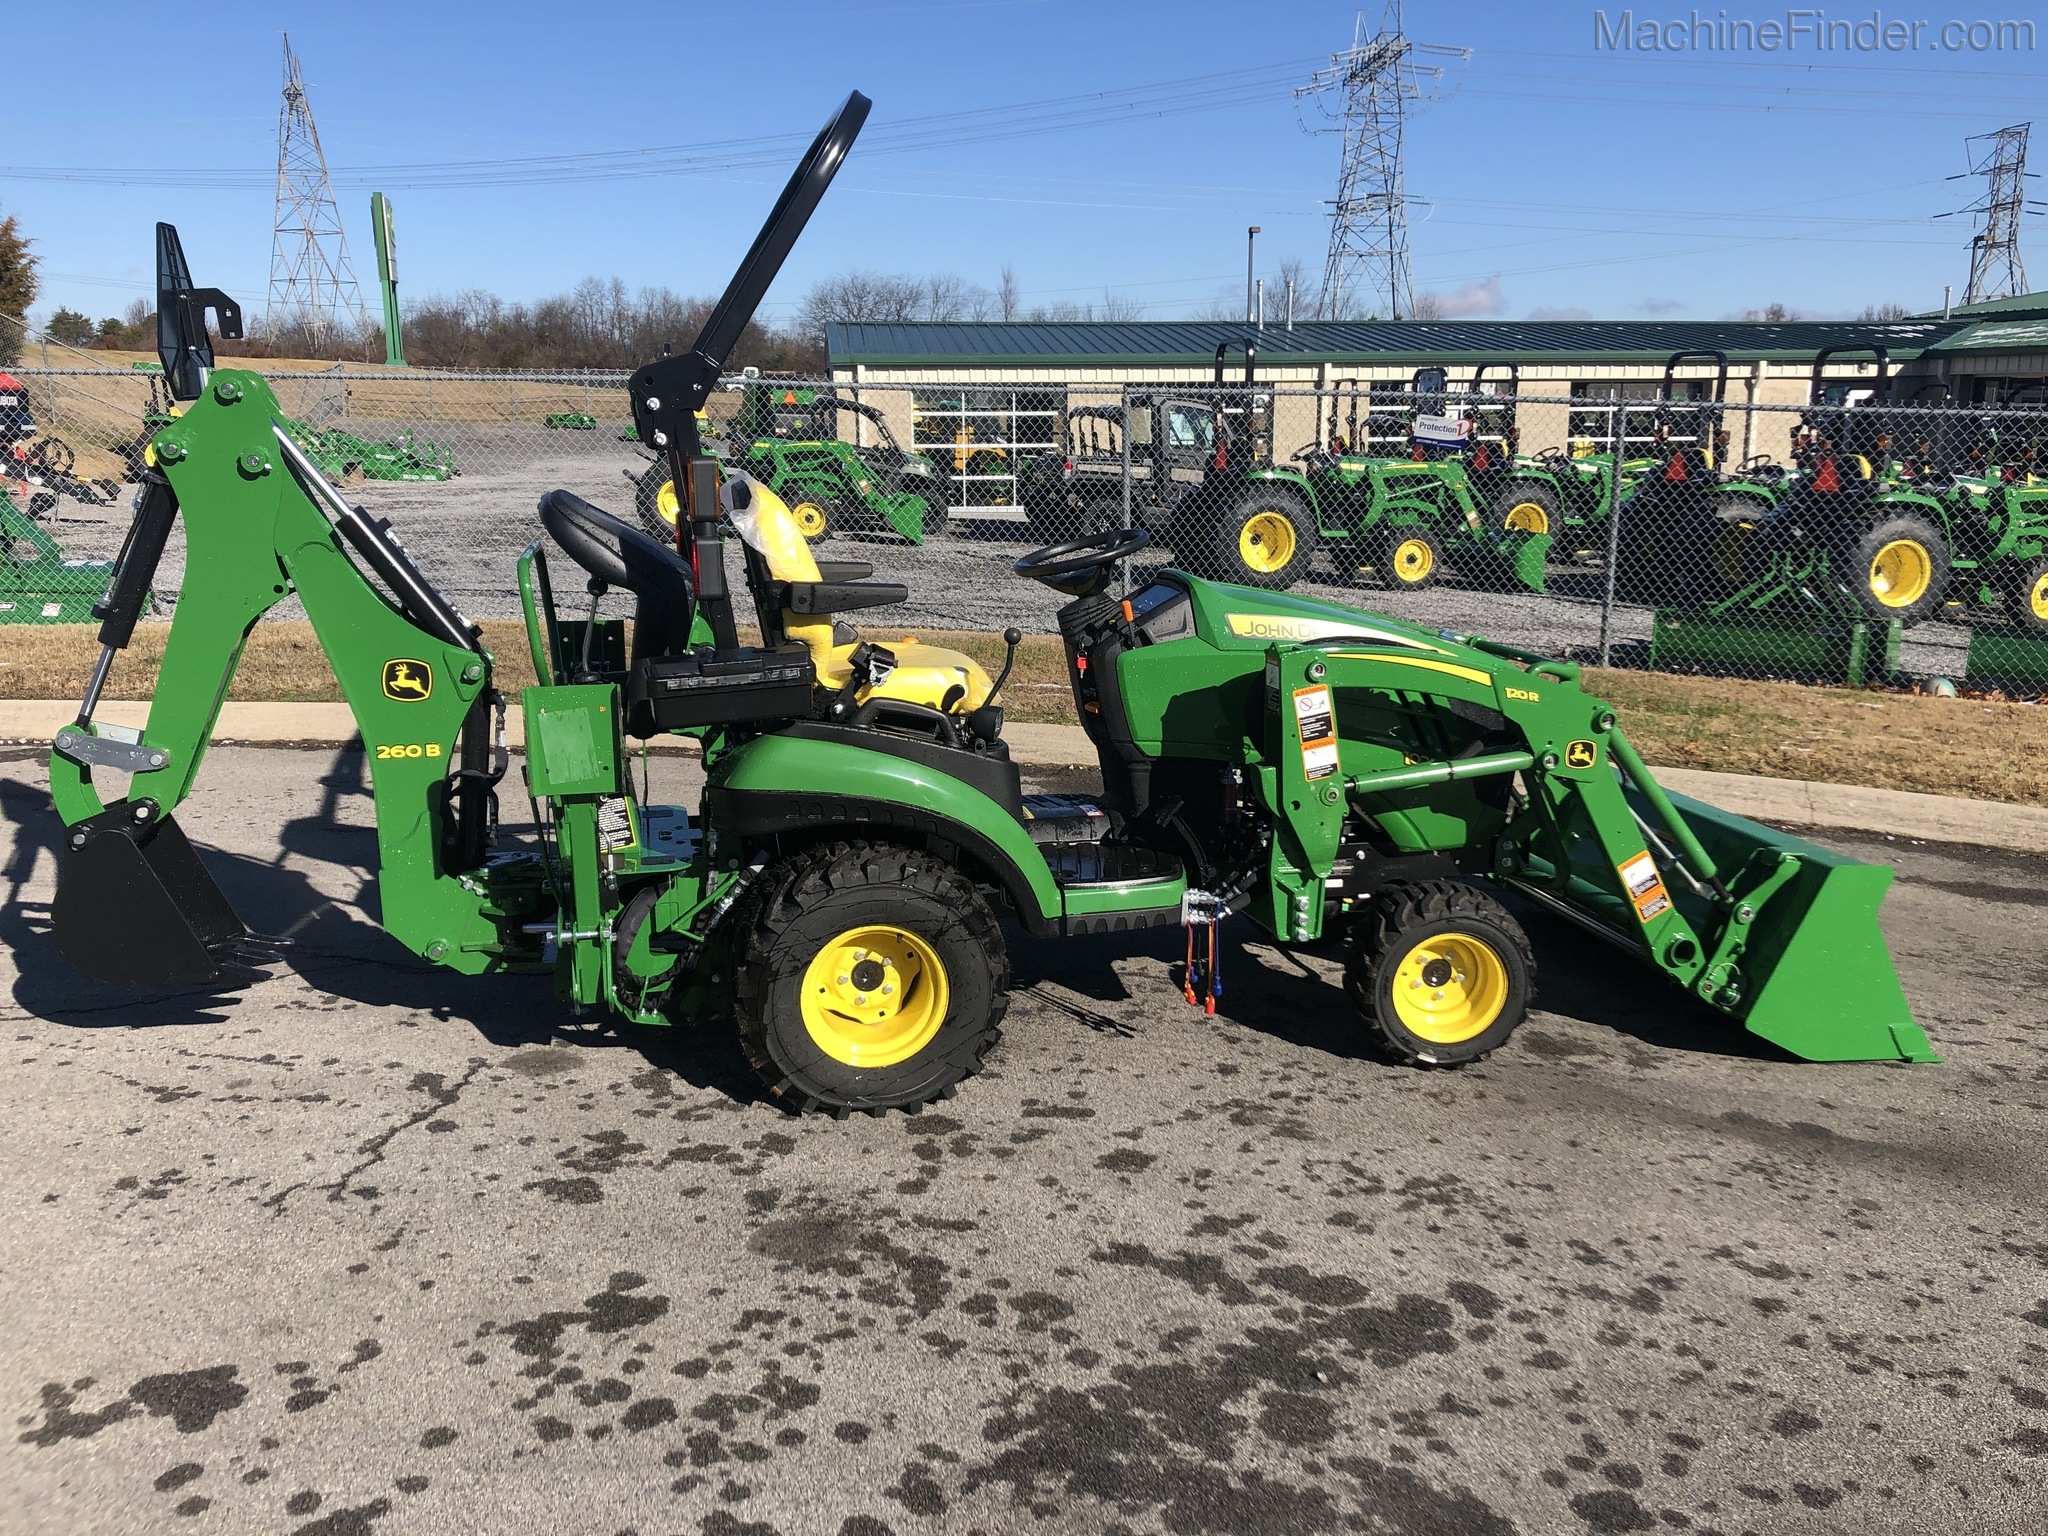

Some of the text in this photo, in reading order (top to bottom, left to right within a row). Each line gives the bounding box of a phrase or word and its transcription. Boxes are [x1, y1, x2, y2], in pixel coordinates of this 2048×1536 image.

[1418, 421, 1458, 434] Protection
[1244, 620, 1294, 637] JOHN
[1300, 686, 1326, 696] WARNING
[1308, 739, 1335, 749] WARNING
[376, 743, 441, 759] 260 B
